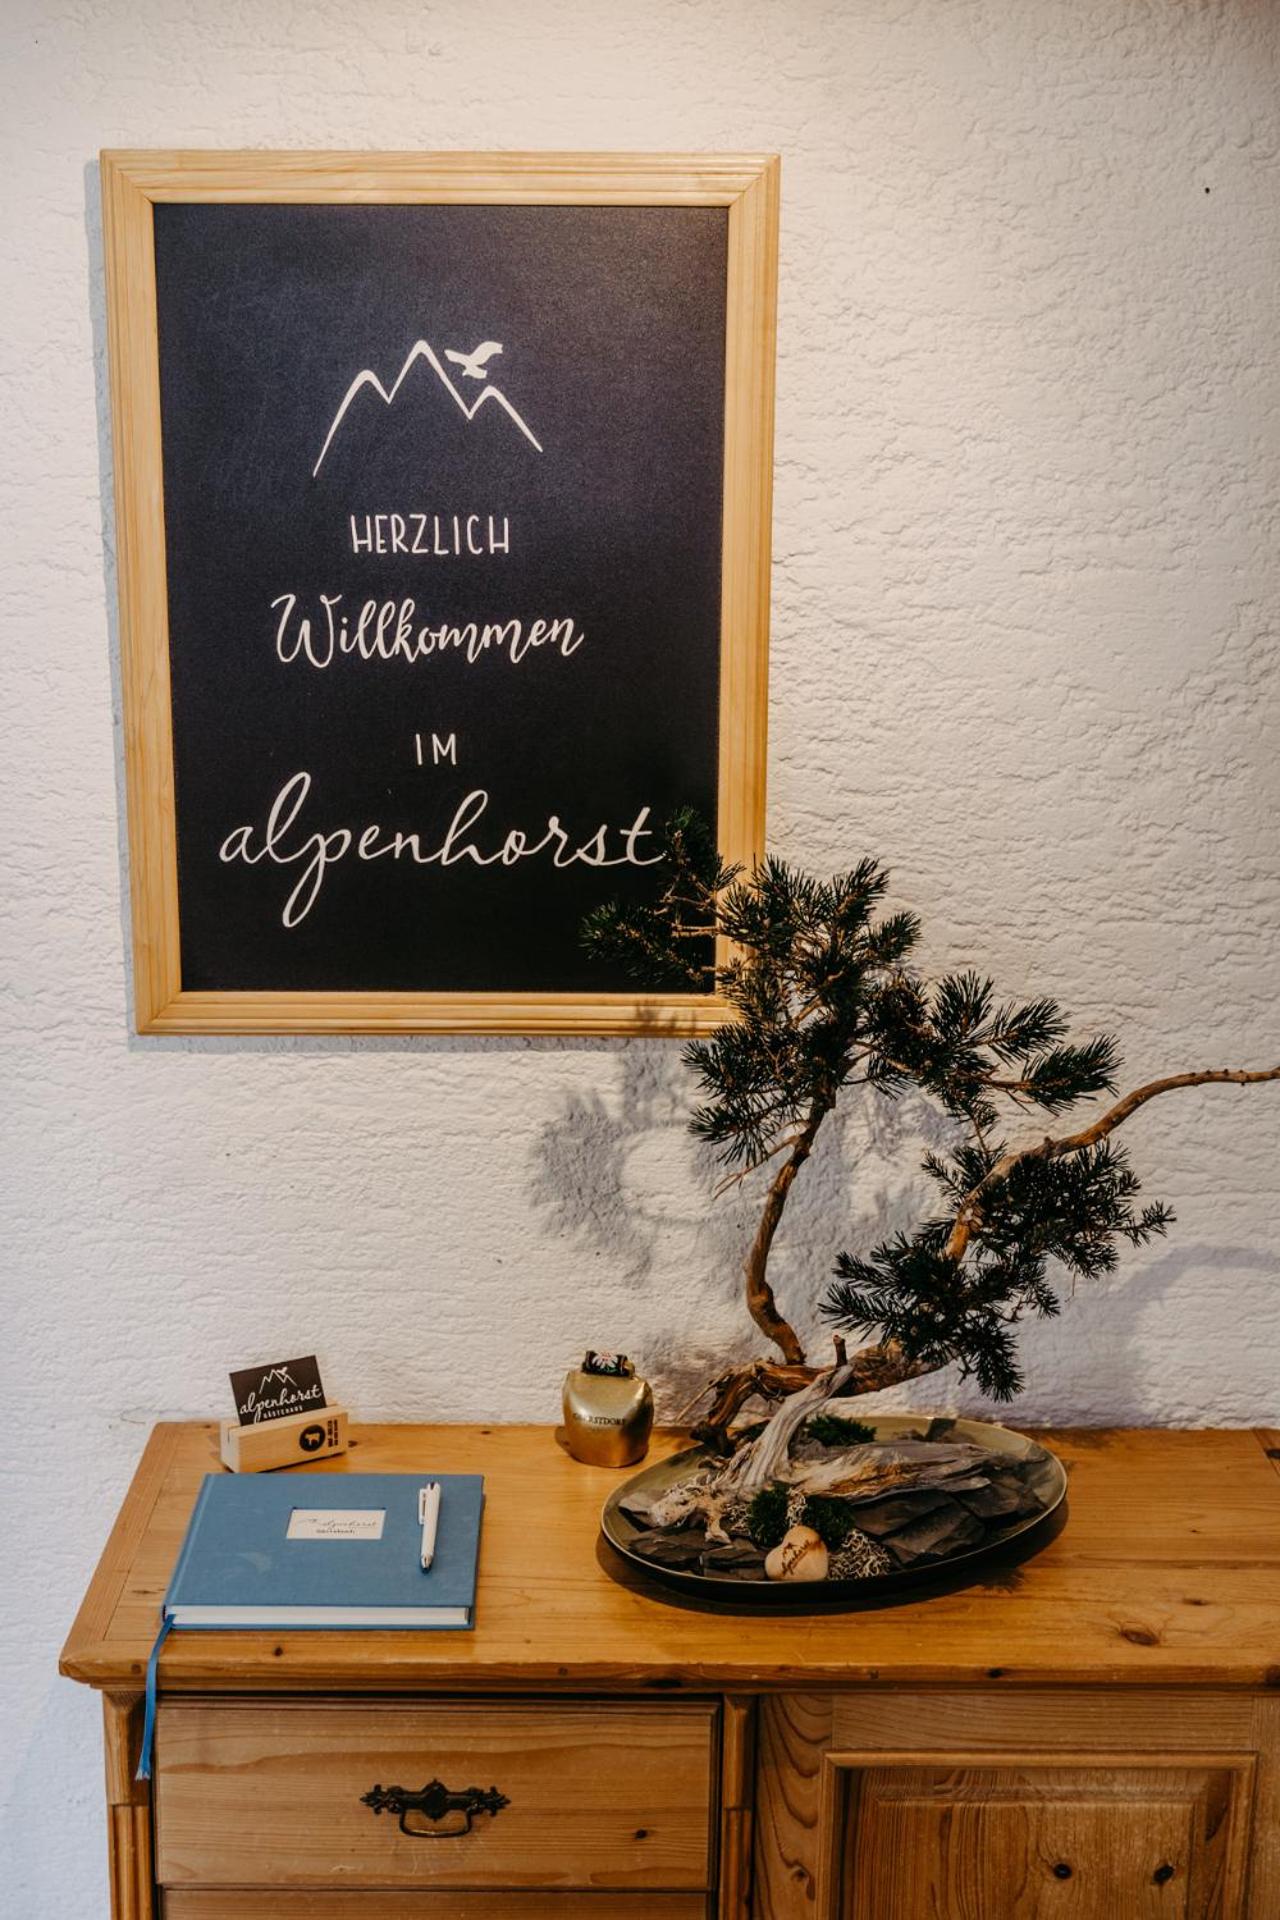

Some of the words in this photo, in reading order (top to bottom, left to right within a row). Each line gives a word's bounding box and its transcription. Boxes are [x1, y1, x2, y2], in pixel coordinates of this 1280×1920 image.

[350, 513, 511, 556] HERZLICH
[270, 593, 585, 669] Willkommen
[415, 733, 458, 766] IM
[218, 771, 666, 928] alpenhorst
[239, 1384, 323, 1424] alpenhorst
